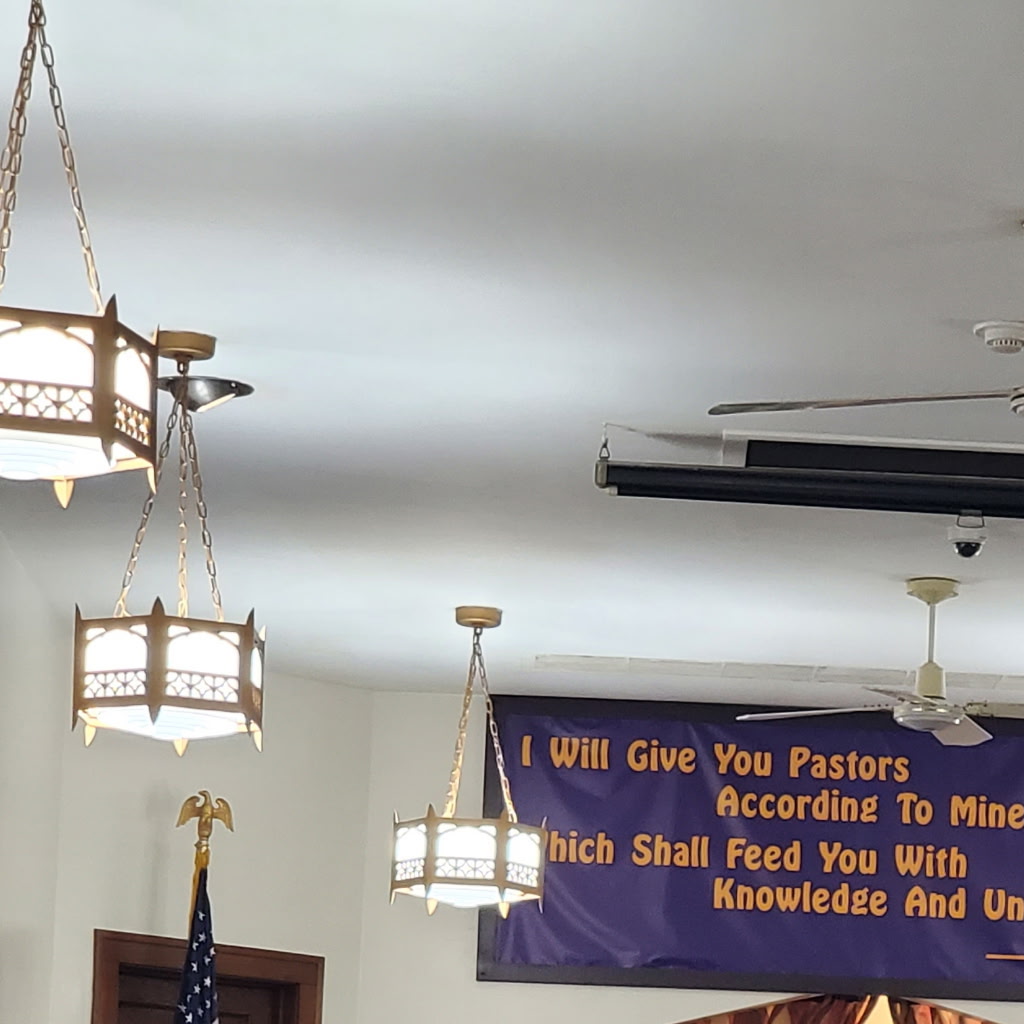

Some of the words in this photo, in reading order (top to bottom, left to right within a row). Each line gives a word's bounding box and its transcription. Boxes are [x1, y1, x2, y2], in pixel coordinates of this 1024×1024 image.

[520, 735, 532, 767] I
[549, 736, 610, 771] Will
[626, 739, 697, 774] Give
[713, 742, 773, 777] You
[788, 746, 910, 783] Pastors
[715, 784, 878, 823] According
[896, 791, 934, 826] To
[548, 830, 615, 865] hich
[631, 833, 710, 868] Shall
[725, 837, 802, 872] Feed
[818, 841, 878, 876] You
[894, 843, 968, 879] With
[712, 877, 888, 917] Knowledge
[903, 885, 967, 920] And
